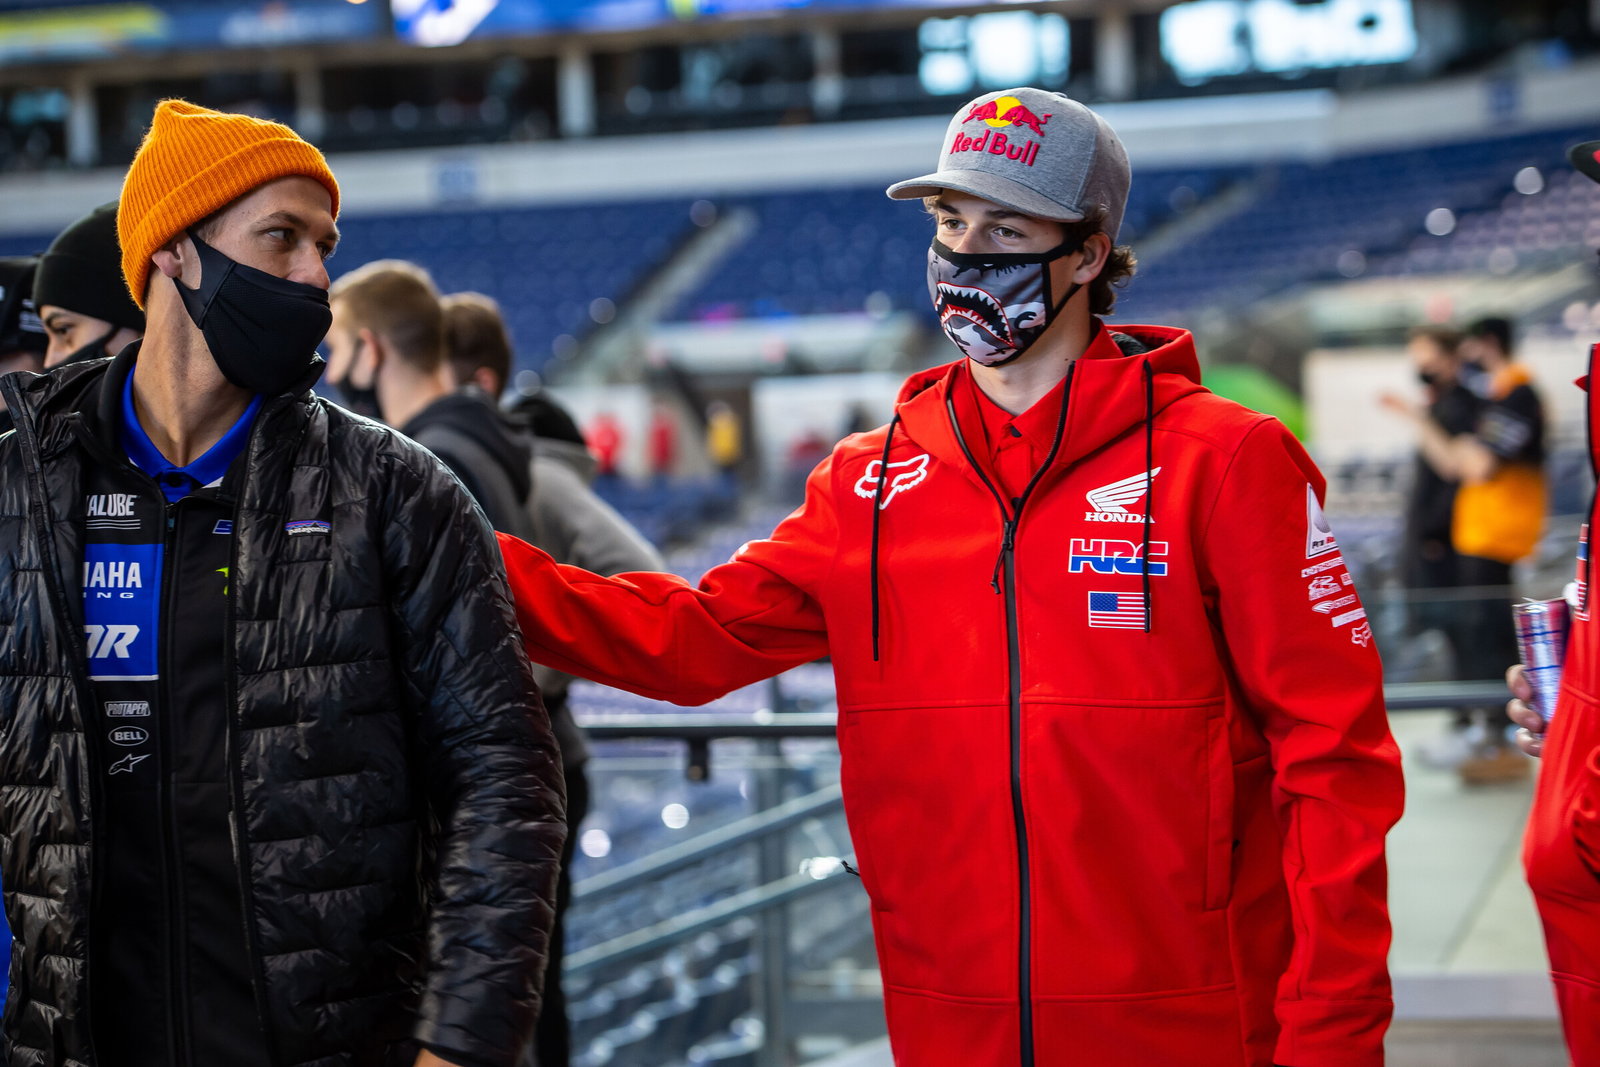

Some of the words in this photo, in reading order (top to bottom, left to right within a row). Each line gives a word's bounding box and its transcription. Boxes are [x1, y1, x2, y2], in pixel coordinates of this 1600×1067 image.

[950, 129, 991, 154] Red
[988, 132, 1040, 167] Bull
[86, 493, 140, 517] ALUBE
[1084, 511, 1156, 524] HONDA
[1068, 538, 1169, 576] HRC
[114, 731, 144, 741] BELL
